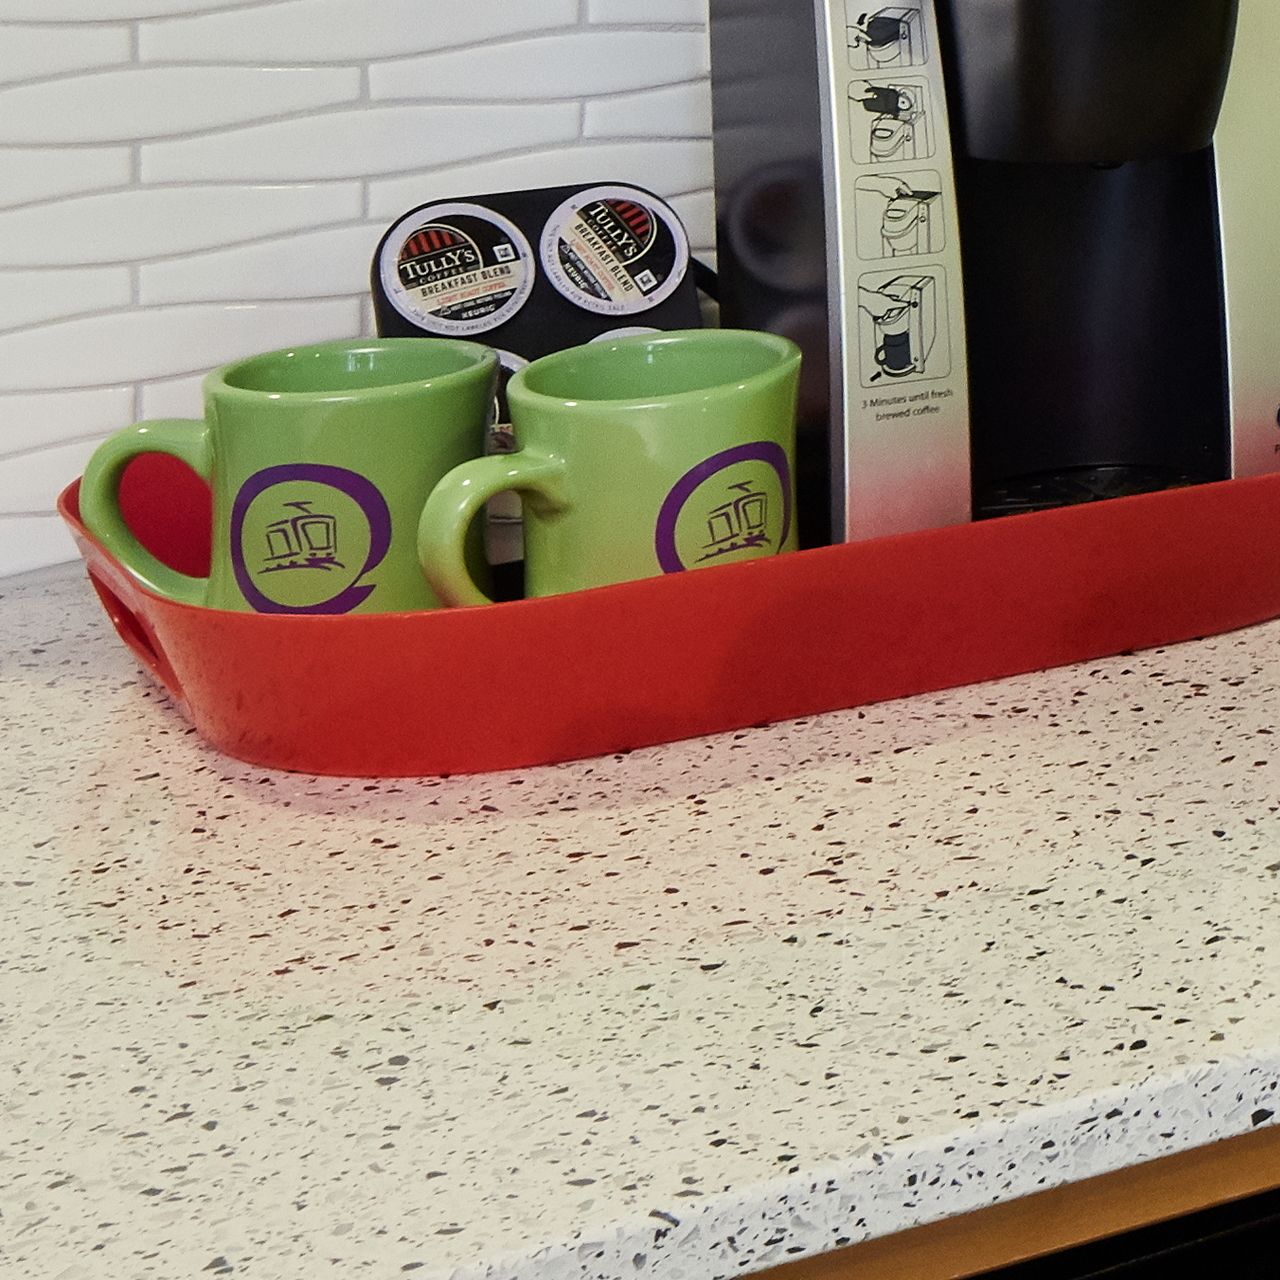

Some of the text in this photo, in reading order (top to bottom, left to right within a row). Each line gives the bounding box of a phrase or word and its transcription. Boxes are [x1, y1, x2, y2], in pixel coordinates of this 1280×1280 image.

[587, 219, 617, 252] COFFEE
[590, 200, 638, 257] TULLY'S
[400, 248, 475, 280] TULLY'S
[574, 223, 614, 265] BREAKFAST
[610, 263, 635, 293] BLEND
[419, 267, 464, 285] COFFEE
[421, 265, 512, 297] BREAKFAST BLEND
[564, 262, 589, 289] KEURIG
[461, 304, 496, 319] KEURIG
[861, 389, 954, 409] 3 Minutes until fresh
[875, 405, 941, 421] brewed coffee
